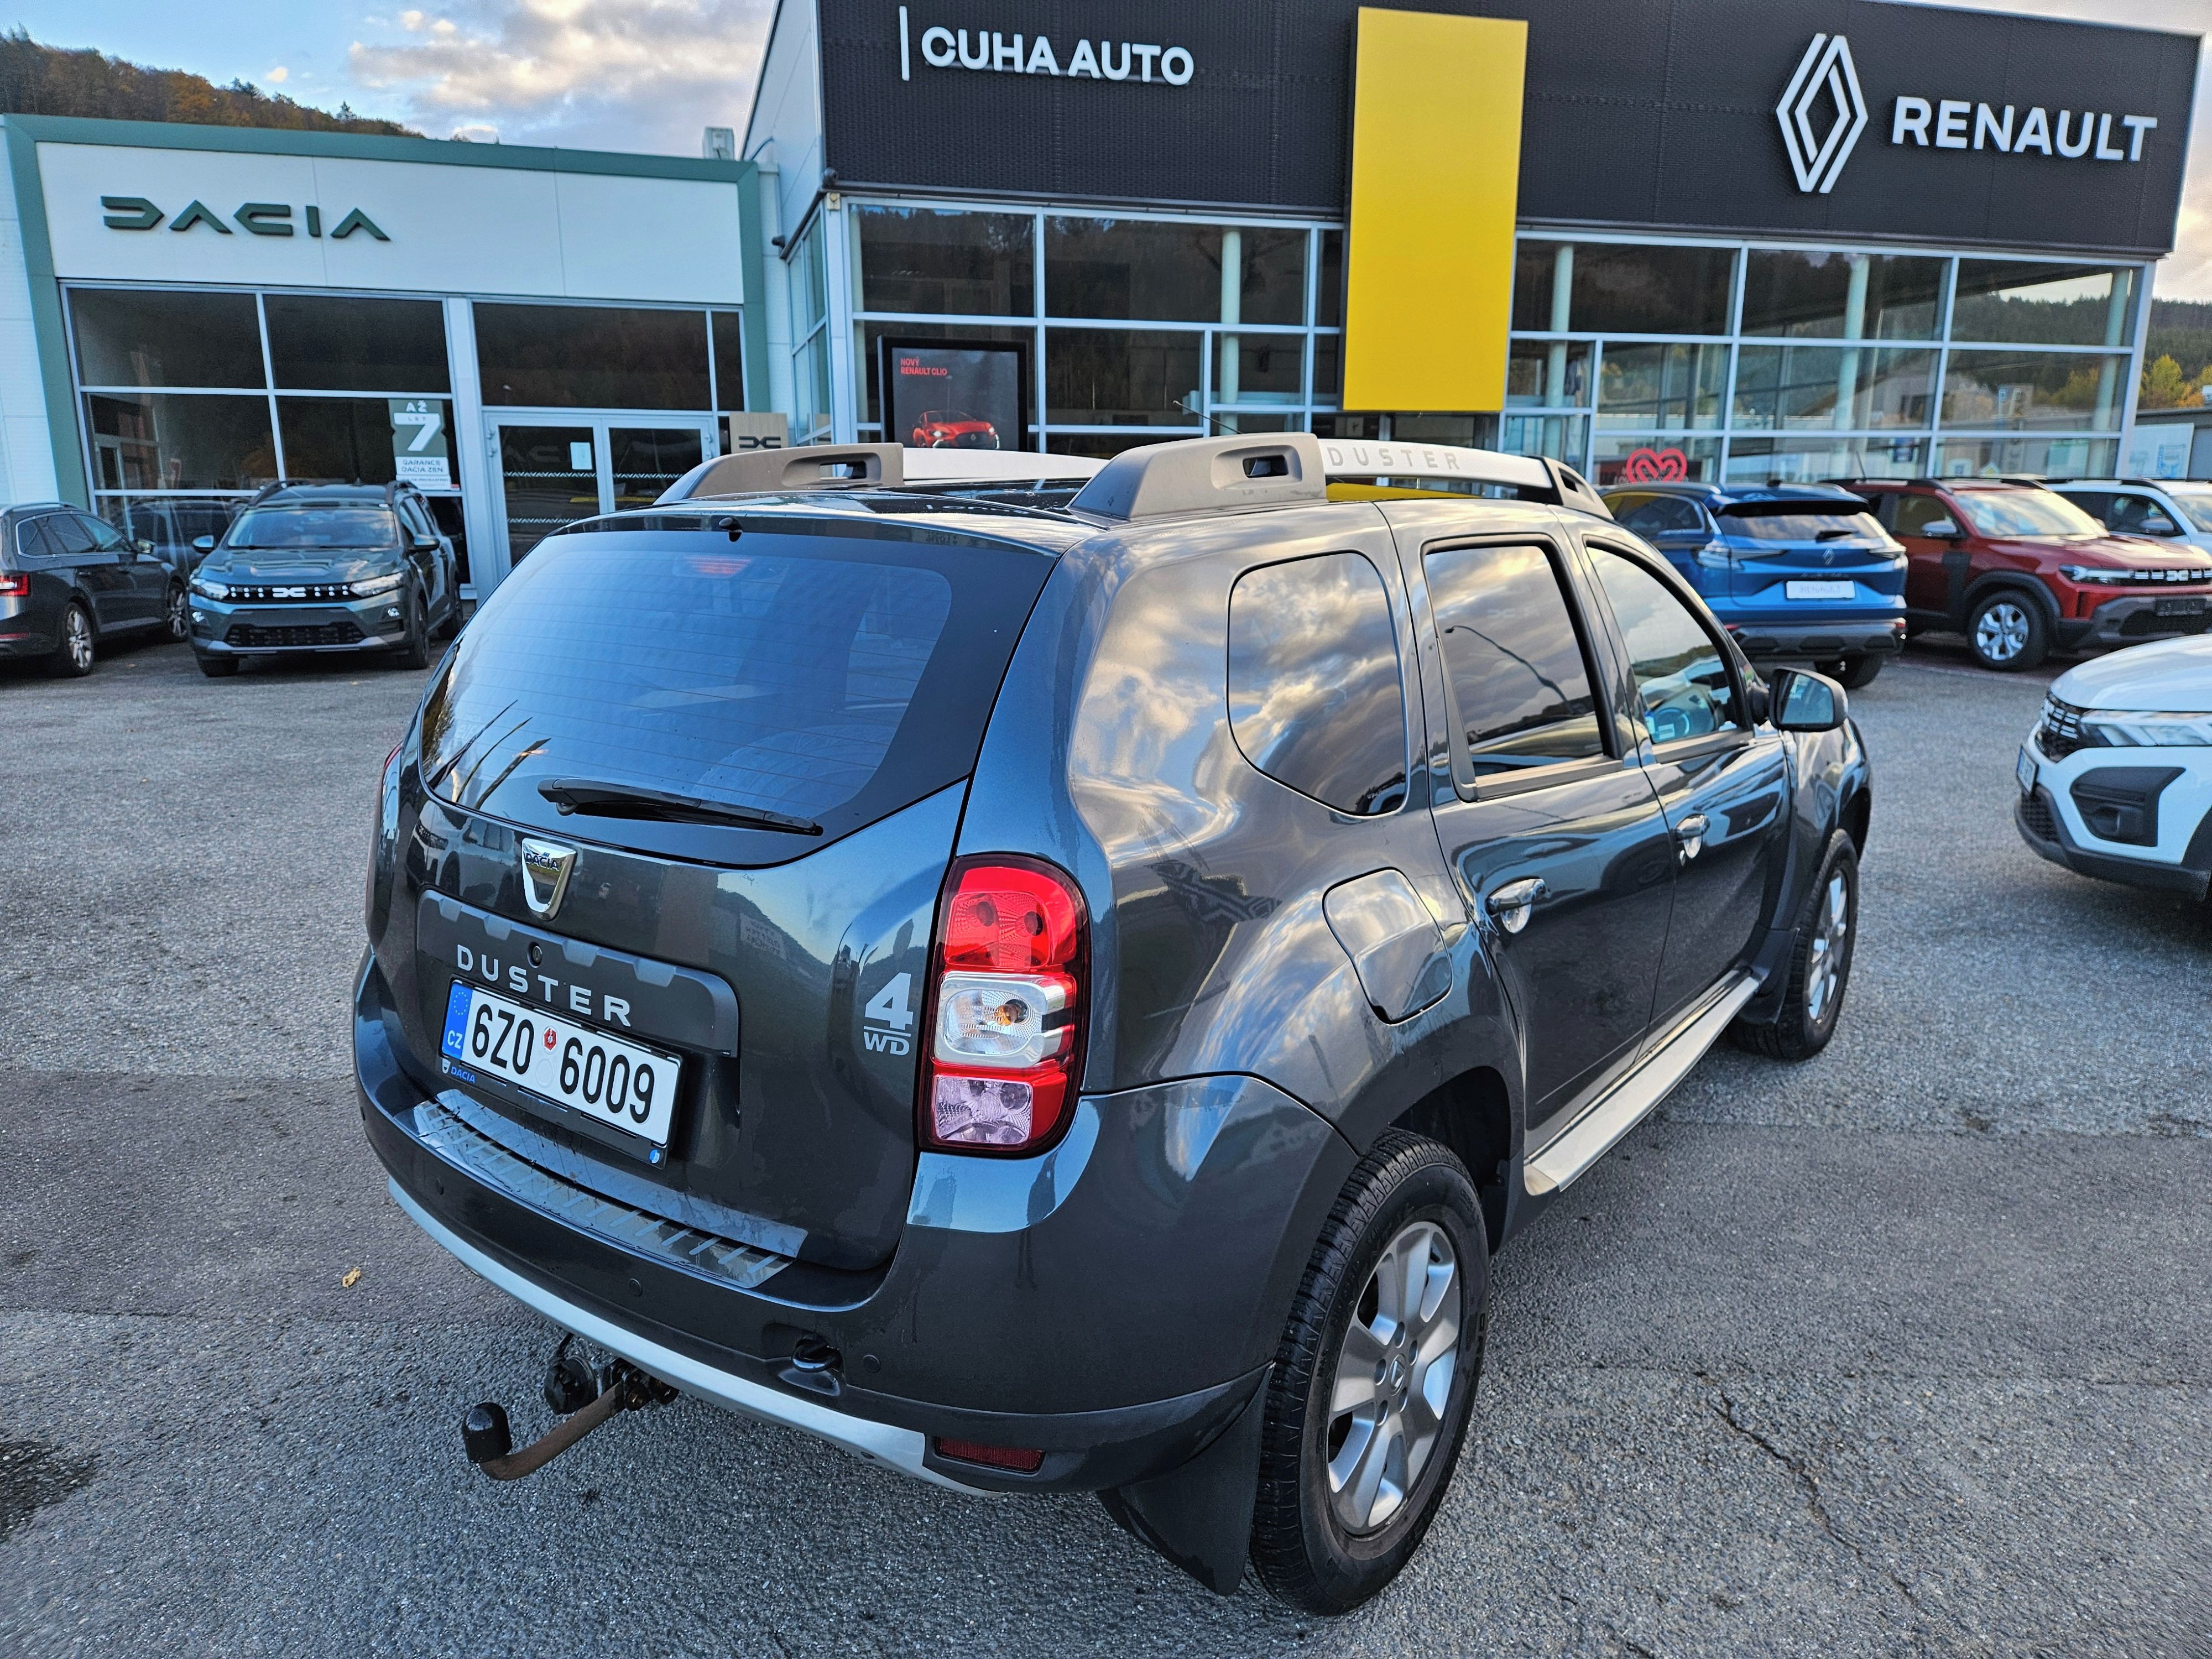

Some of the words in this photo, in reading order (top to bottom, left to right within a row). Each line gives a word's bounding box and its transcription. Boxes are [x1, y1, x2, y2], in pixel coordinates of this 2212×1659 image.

[921, 27, 1060, 76] CUHA
[1067, 39, 1194, 86] AUTO
[1892, 96, 2157, 161] RENAULT
[101, 196, 390, 242] DACIA
[900, 356, 920, 366] NOVÝ
[901, 366, 930, 375] RENAULT
[931, 368, 947, 376] CLIO
[406, 400, 427, 413] AŽ
[394, 413, 441, 451] 7
[1328, 447, 1459, 469] DUSTER
[525, 852, 560, 872] DACIA
[457, 944, 632, 1027] DUSTER
[447, 1030, 463, 1049] CZ
[451, 1066, 476, 1084] DACIA
[472, 1004, 535, 1075] 6Z0
[560, 1037, 655, 1124] 6009
